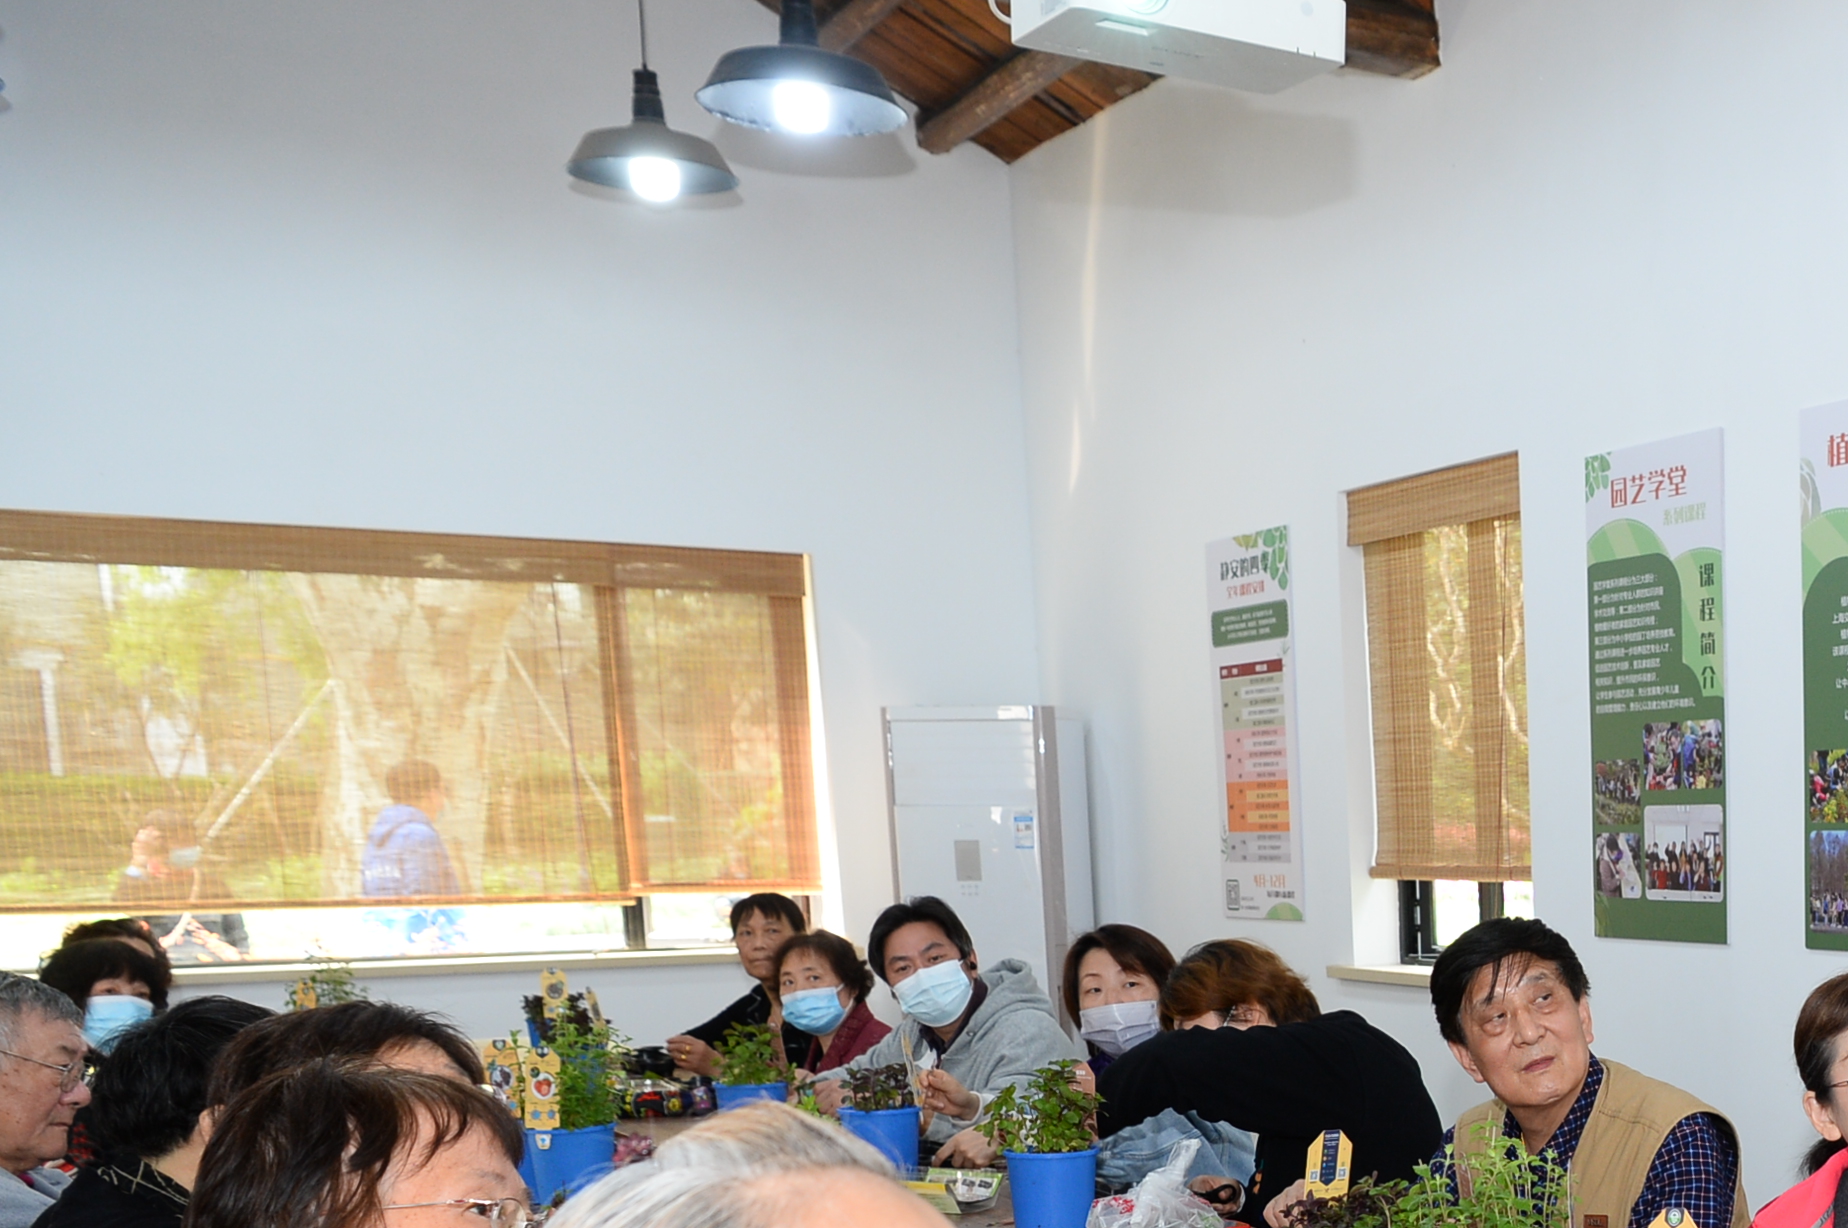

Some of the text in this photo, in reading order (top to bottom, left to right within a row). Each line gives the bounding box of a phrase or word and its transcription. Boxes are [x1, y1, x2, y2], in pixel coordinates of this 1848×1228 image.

[1610, 464, 1687, 509] 园艺学堂
[1663, 501, 1706, 527] 系列课程
[1699, 562, 1716, 690] 课程简介
